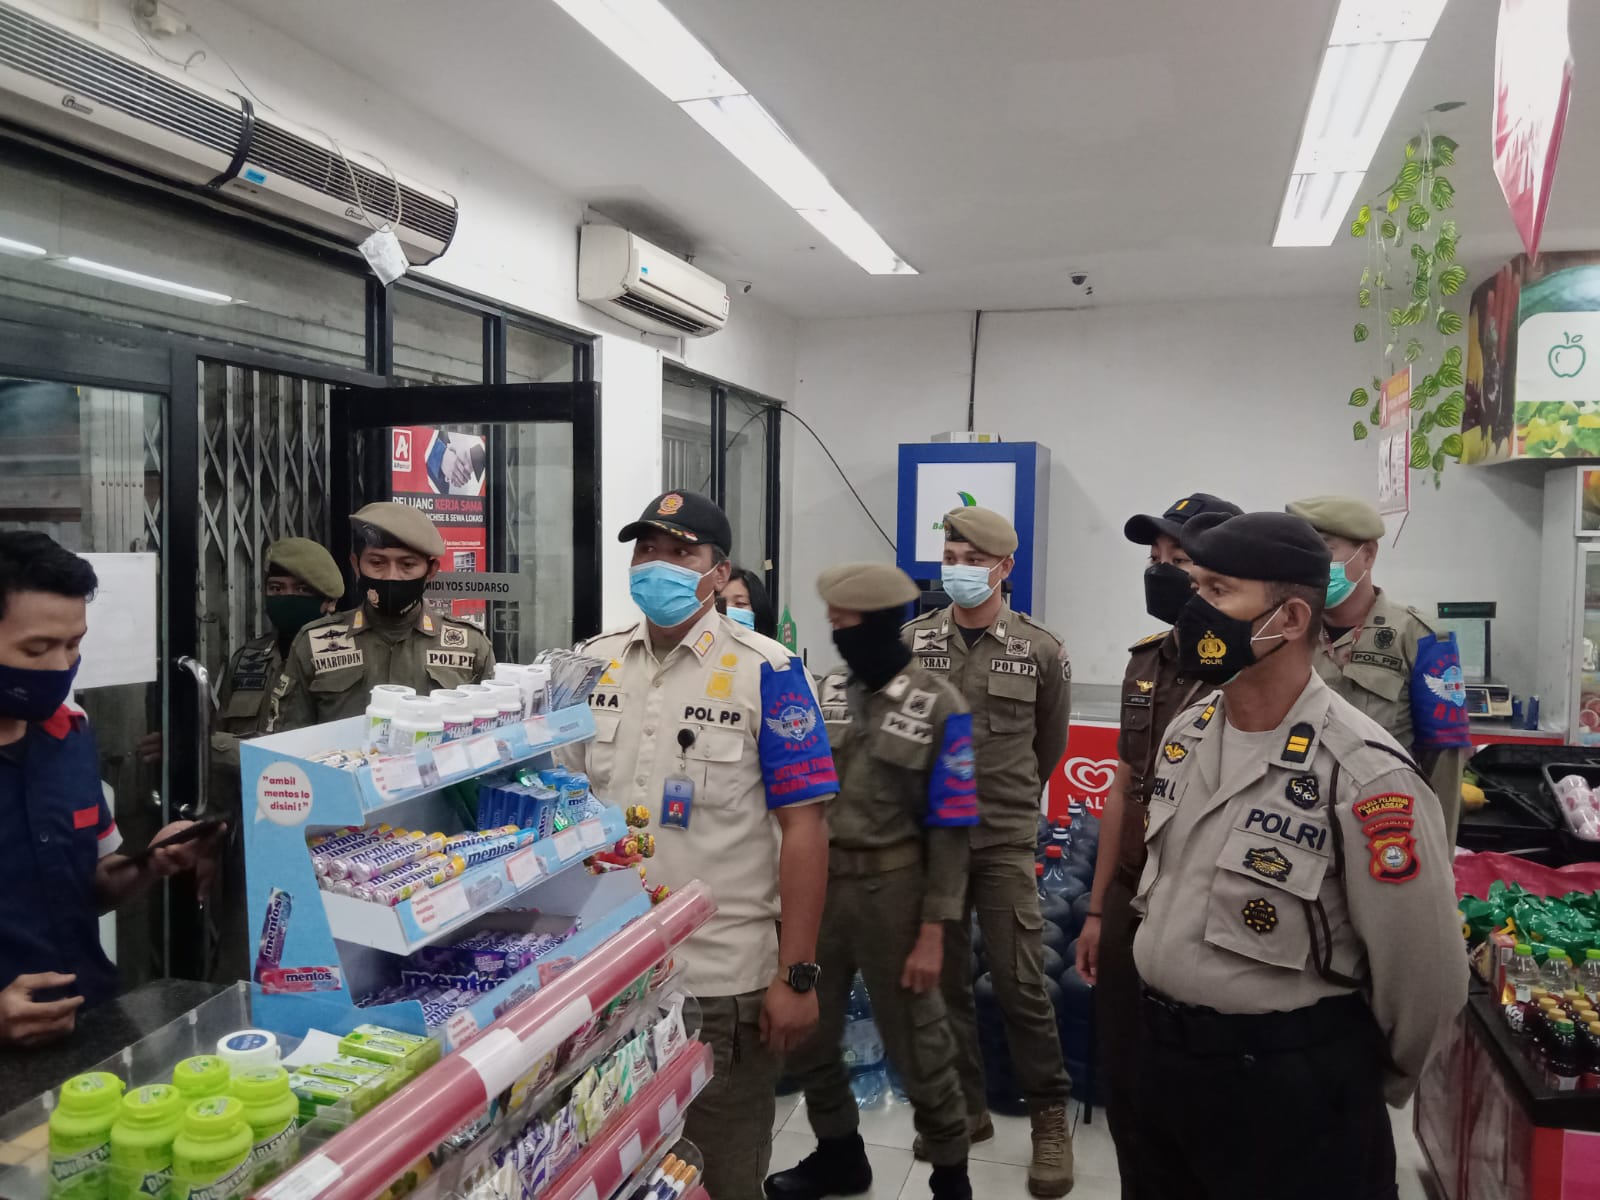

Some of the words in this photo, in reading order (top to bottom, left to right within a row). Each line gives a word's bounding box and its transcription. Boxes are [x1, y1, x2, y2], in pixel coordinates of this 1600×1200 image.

[445, 582, 464, 591] YOS
[465, 582, 510, 593] SUDARSO
[313, 652, 361, 671] AMARUDDIN
[429, 653, 456, 666] POL
[921, 657, 948, 668] SRAN
[994, 660, 1015, 672] POL
[1019, 662, 1034, 674] PP
[1354, 653, 1378, 663] POL
[1382, 657, 1398, 667] PP
[684, 706, 715, 723] POL
[719, 710, 741, 726] PP
[264, 790, 300, 798] mentos
[300, 790, 310, 799] lo
[1246, 808, 1327, 850] POLRI
[351, 840, 401, 864] mentos
[374, 841, 423, 867] mentos
[467, 841, 516, 866] mentos
[370, 860, 422, 886] mentos
[390, 864, 440, 890] mentos
[264, 898, 282, 957] mentos
[286, 972, 332, 982] mentos
